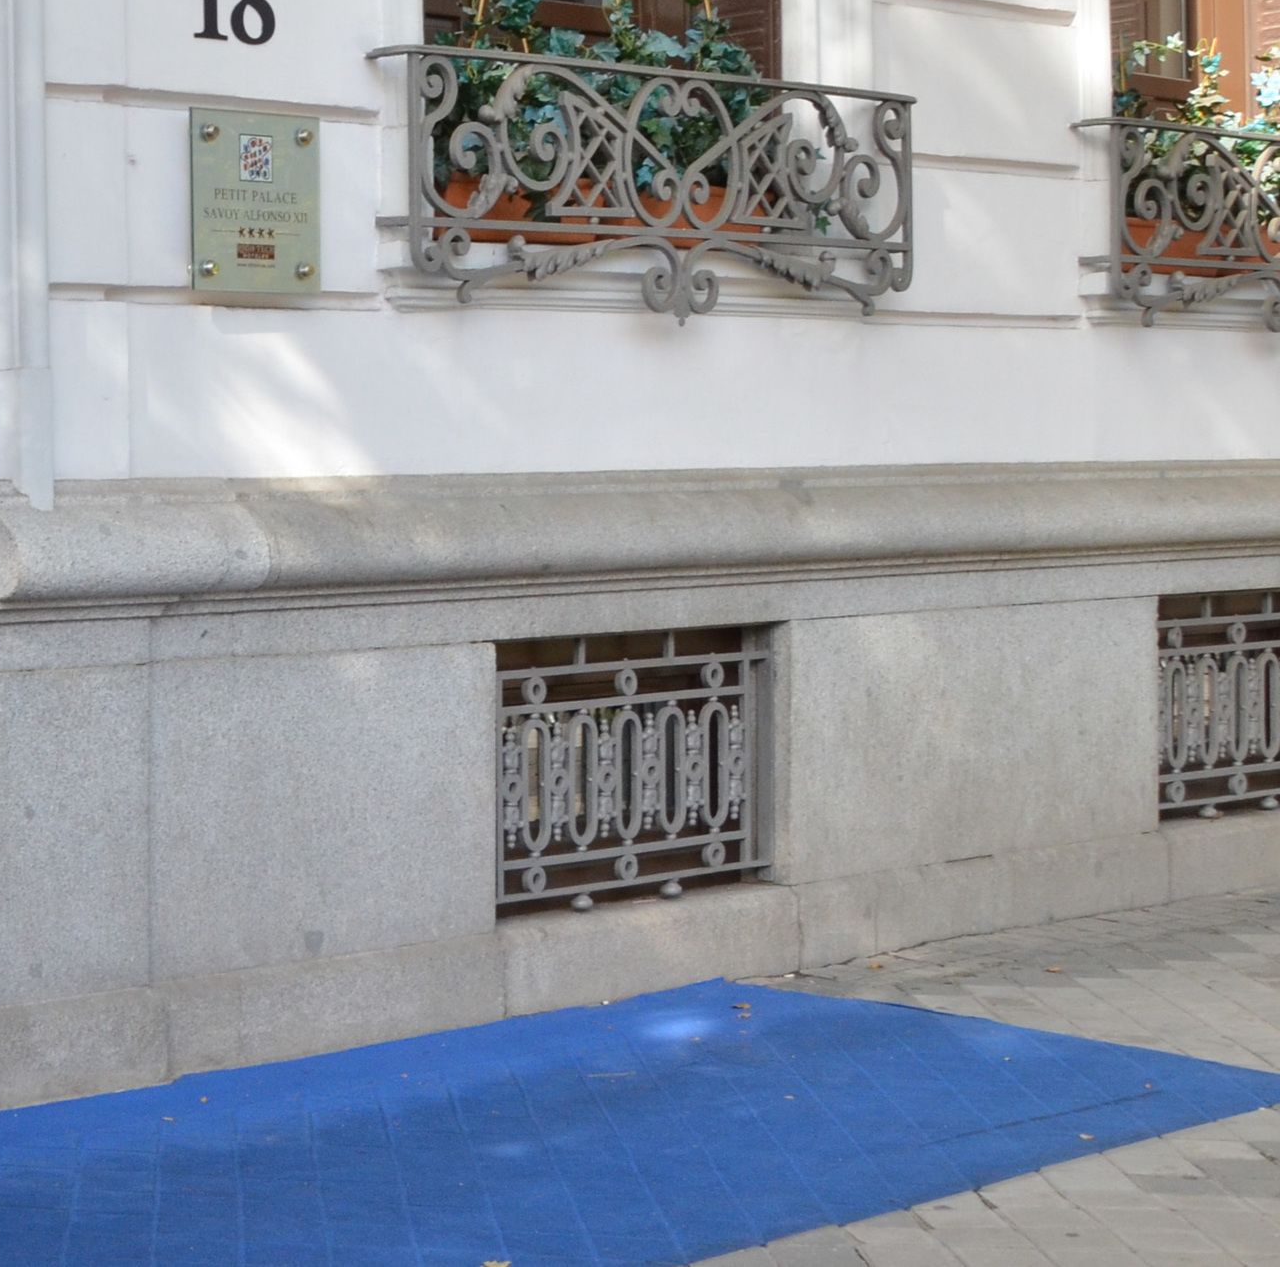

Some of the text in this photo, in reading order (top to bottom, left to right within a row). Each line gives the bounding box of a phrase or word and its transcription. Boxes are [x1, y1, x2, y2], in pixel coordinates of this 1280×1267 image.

[214, 188, 298, 205] PETIT PALACE
[203, 207, 241, 220] SAVOY
[243, 209, 291, 223] ALFONSO
